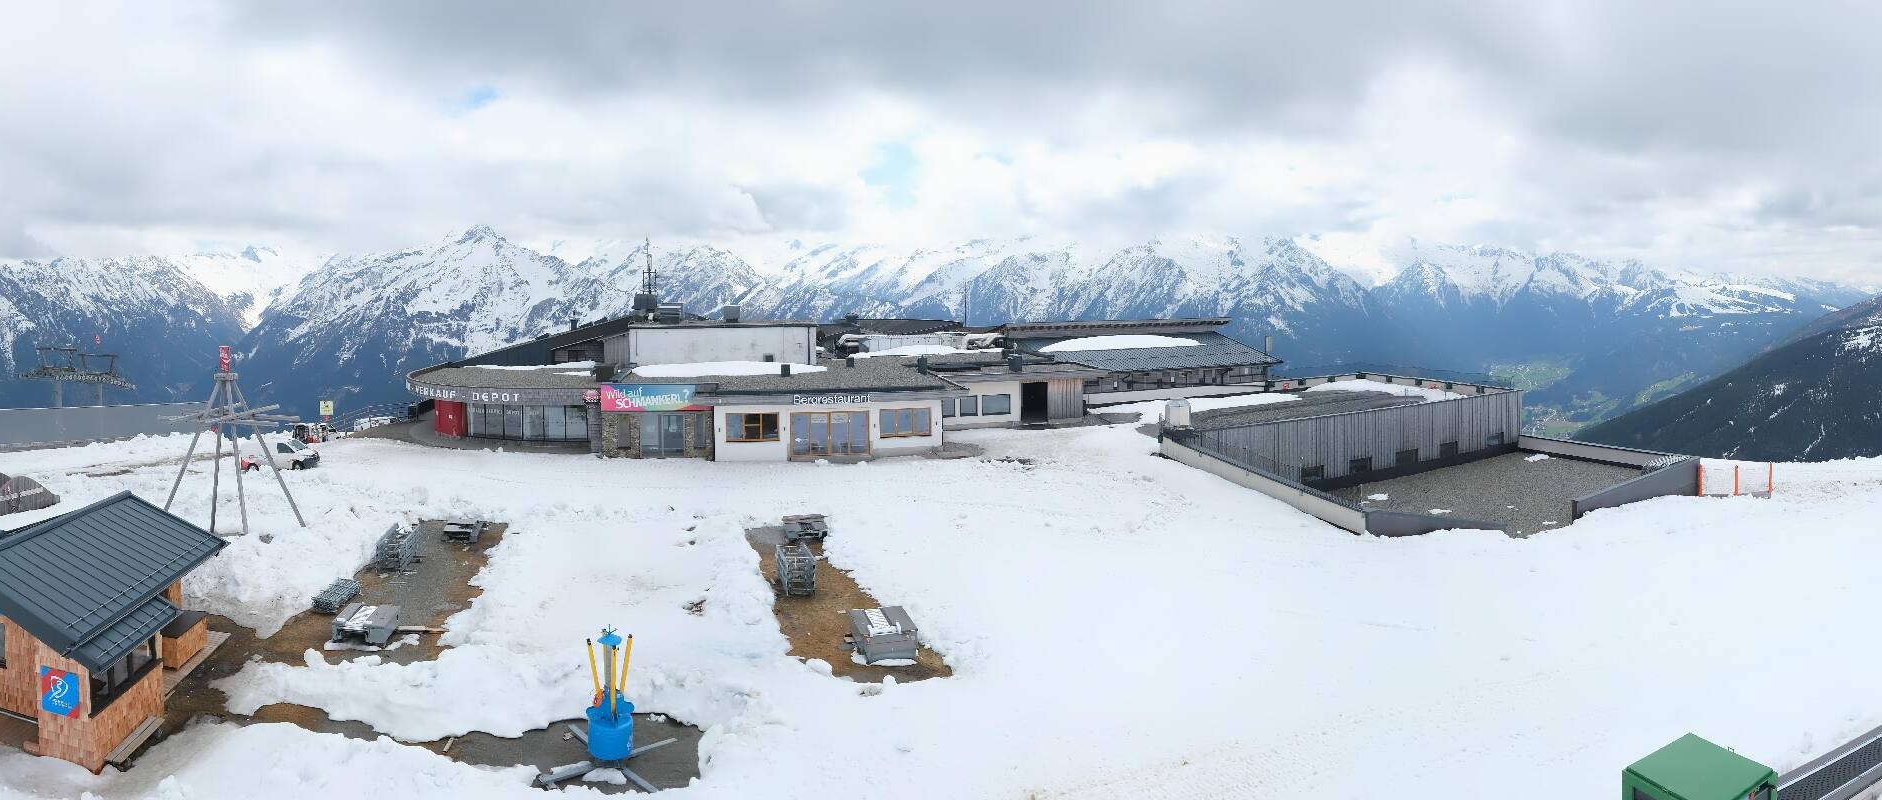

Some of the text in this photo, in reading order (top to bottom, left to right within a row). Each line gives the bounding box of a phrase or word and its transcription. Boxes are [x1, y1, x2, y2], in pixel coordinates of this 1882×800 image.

[415, 385, 457, 399] VERKAUF
[472, 392, 520, 403] DEPOT
[605, 387, 643, 400] Wild auf
[793, 394, 870, 406] Bergrestaurant
